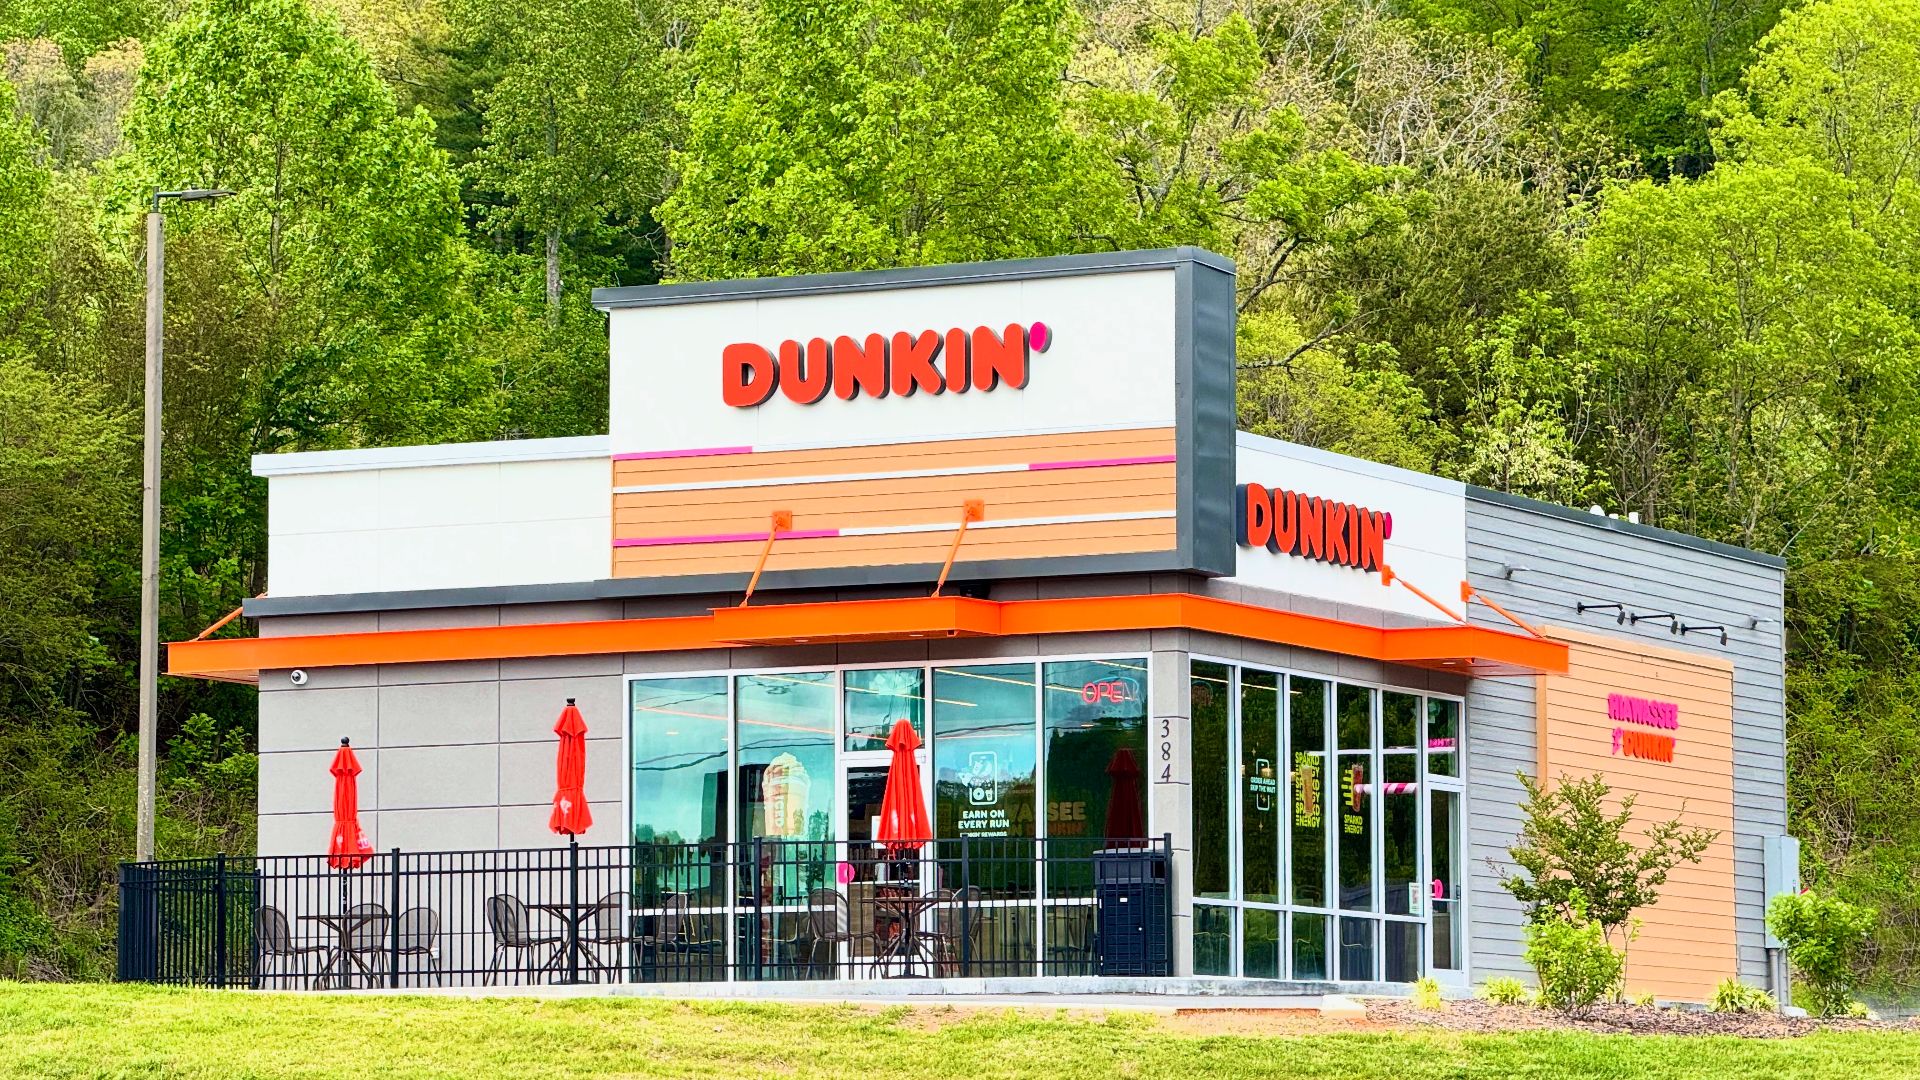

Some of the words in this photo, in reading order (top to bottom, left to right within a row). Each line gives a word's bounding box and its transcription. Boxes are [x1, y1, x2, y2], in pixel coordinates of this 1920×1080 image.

[723, 321, 1052, 407] DUNKIN'
[1246, 482, 1393, 573] DUNKIN'
[1081, 681, 1137, 704] OPEN
[1608, 693, 1679, 730] HIAWASSEE
[957, 820, 987, 830] EVERY
[989, 819, 1010, 828] RUN
[962, 810, 987, 819] EARN
[989, 809, 1005, 819] ON
[1295, 815, 1321, 828] ENERGY
